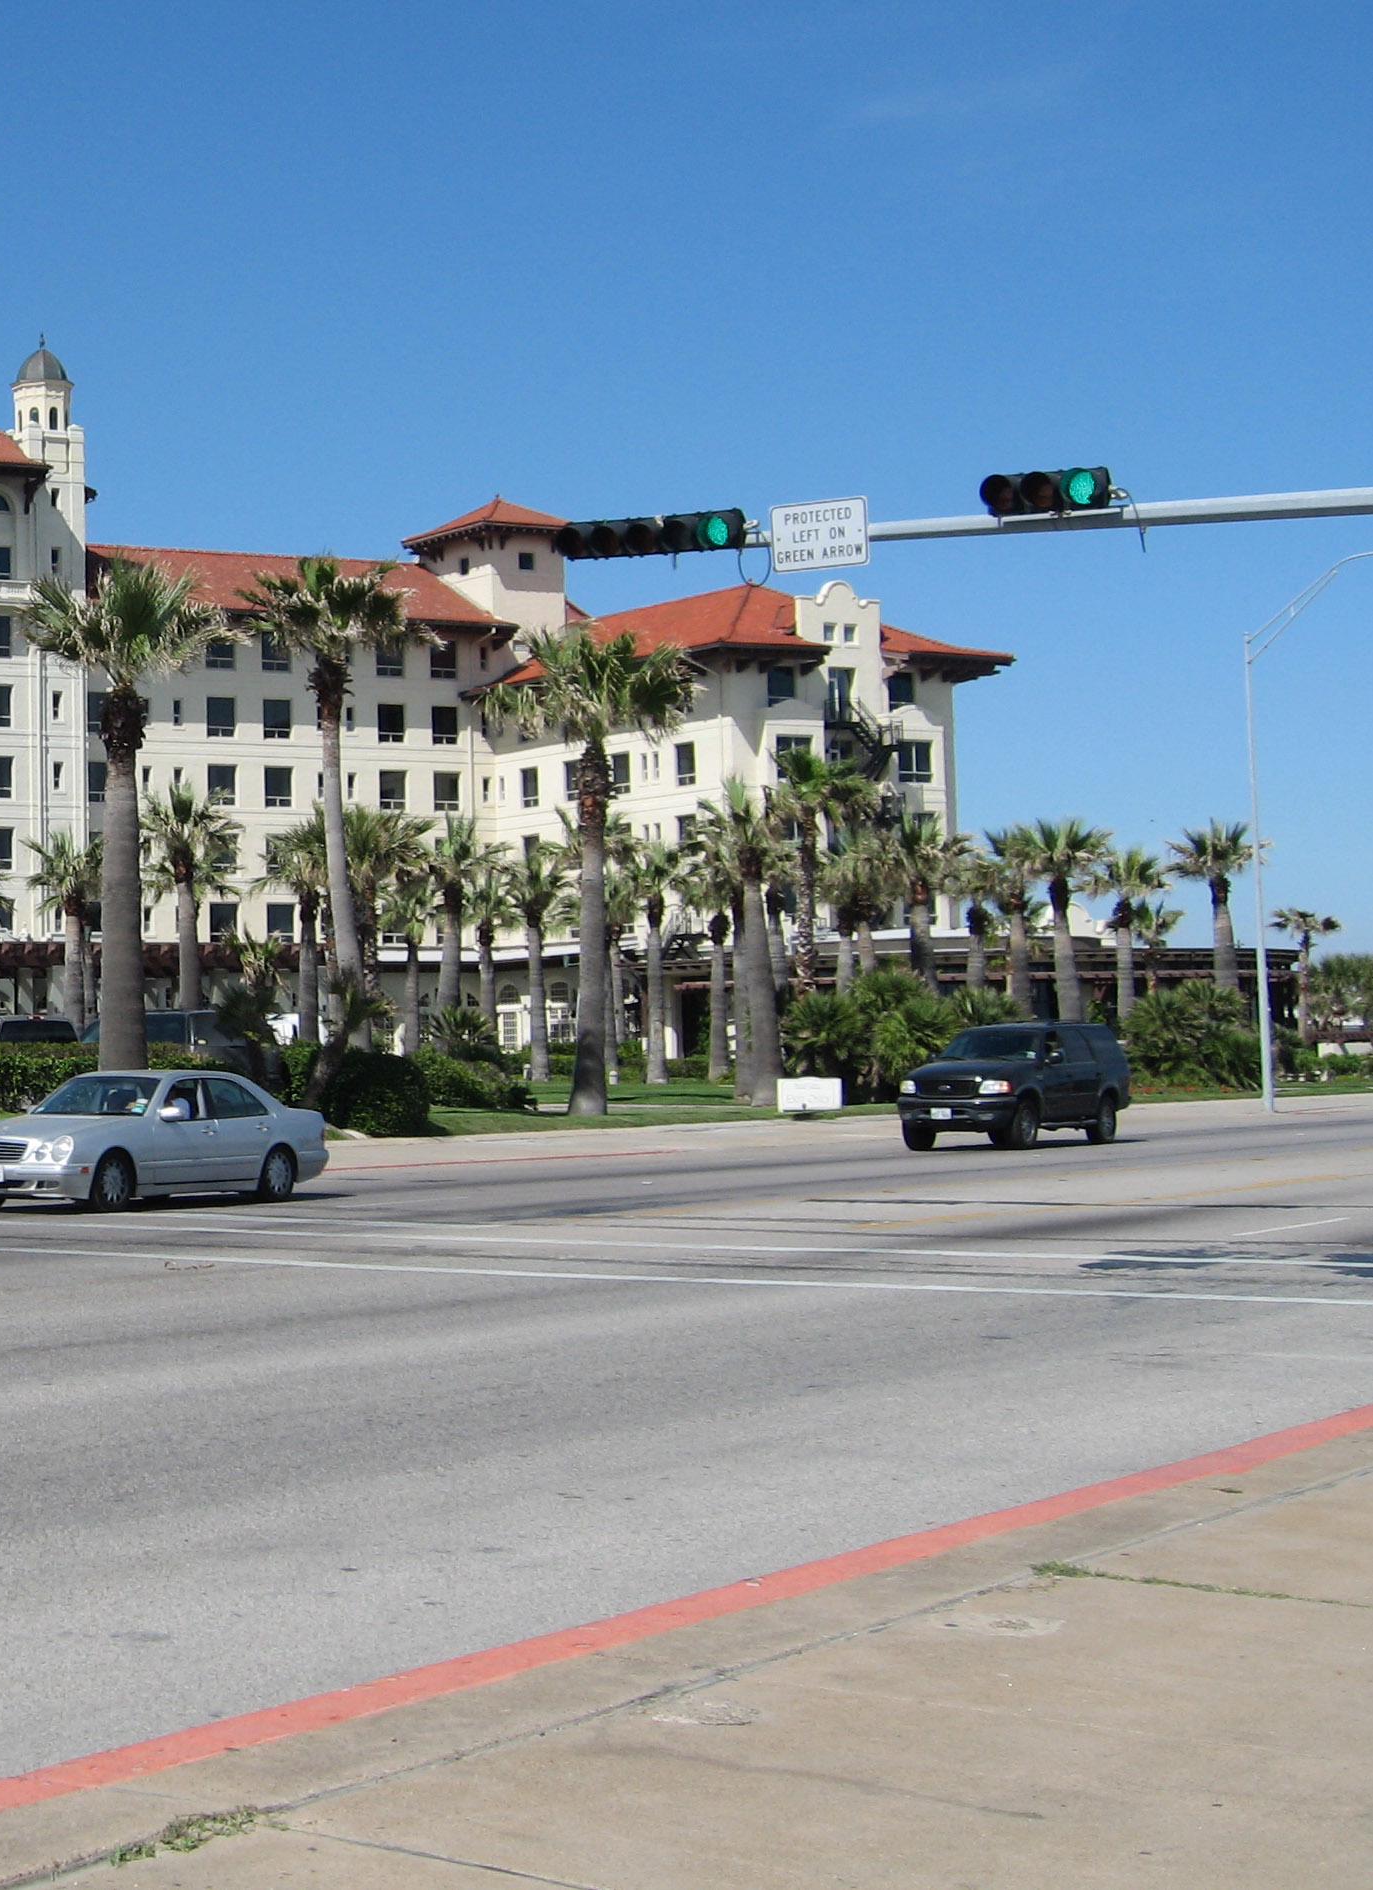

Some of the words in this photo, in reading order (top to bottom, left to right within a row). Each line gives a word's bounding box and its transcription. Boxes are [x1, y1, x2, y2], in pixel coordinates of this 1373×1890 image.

[784, 506, 852, 526] PROTECTED
[792, 528, 820, 544] LEFT
[829, 526, 846, 540] ON
[776, 548, 815, 564] GREEN
[822, 543, 864, 559] ARROW
